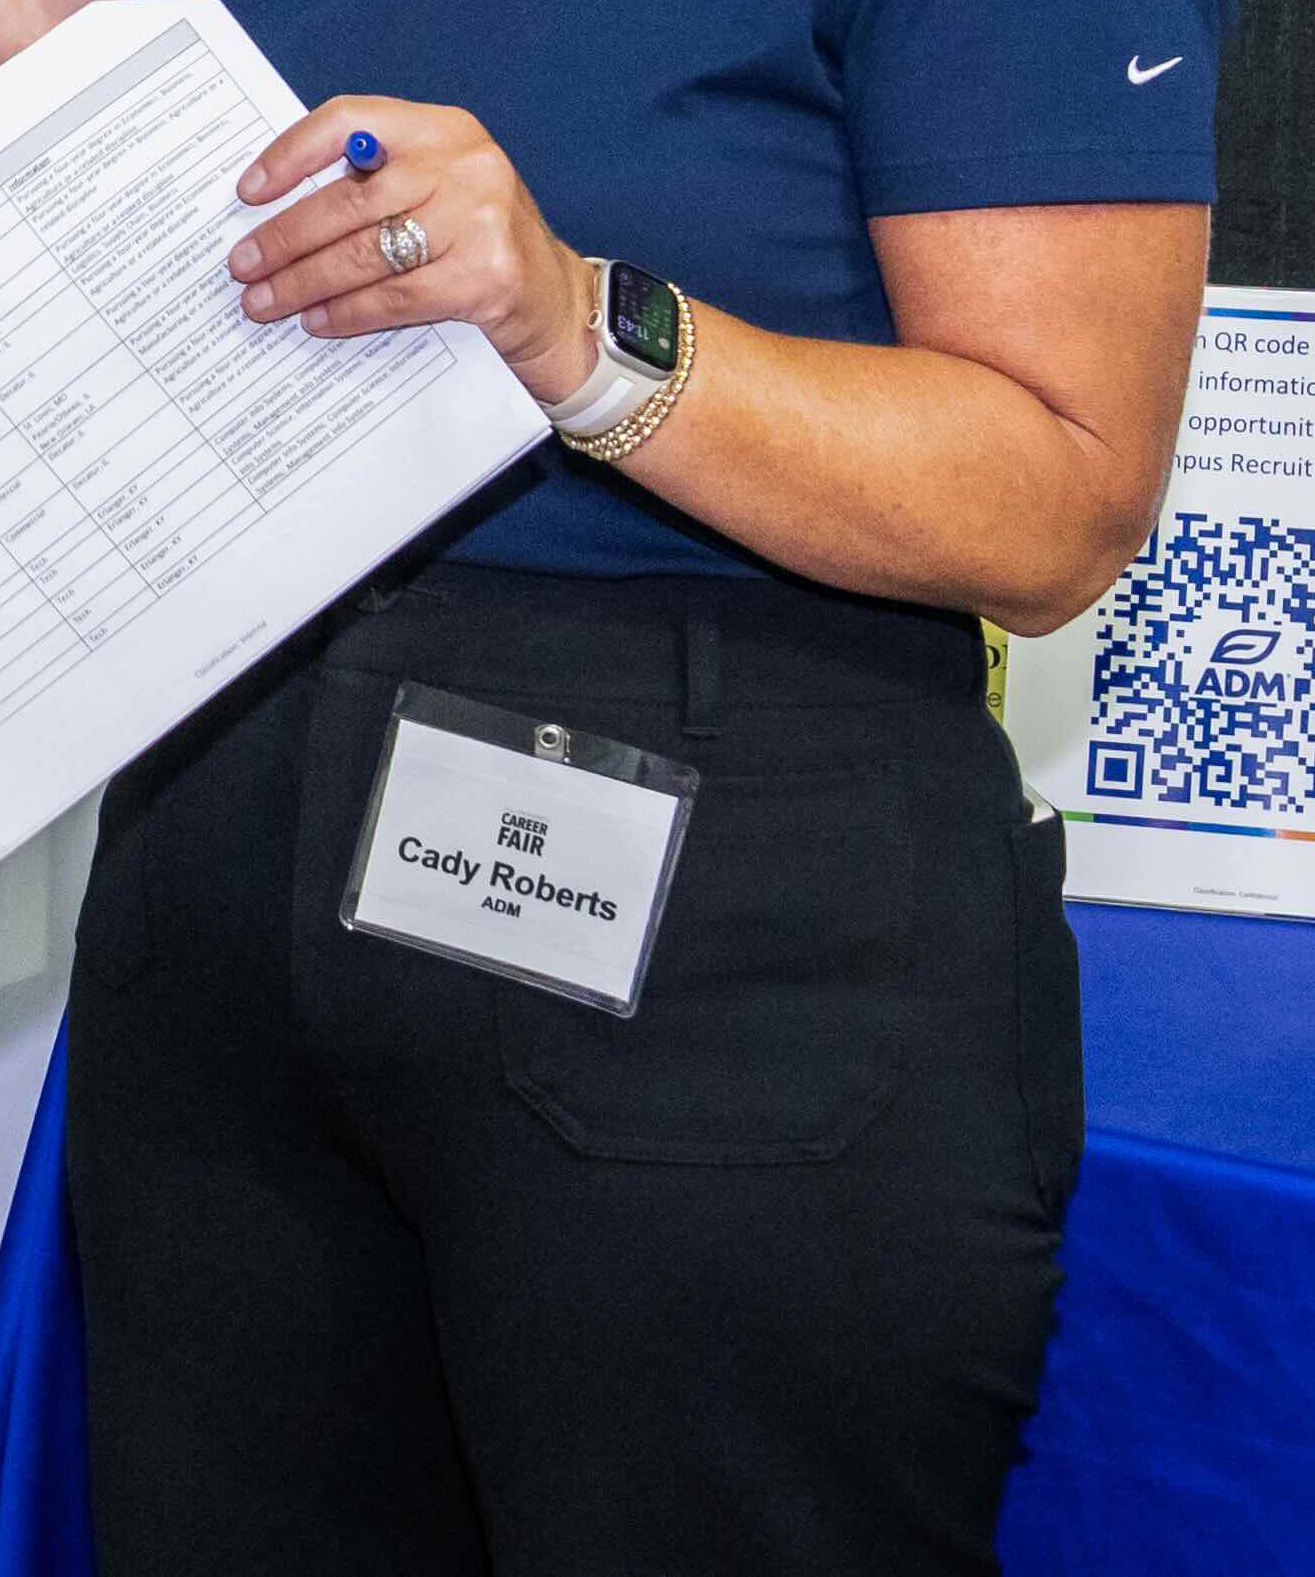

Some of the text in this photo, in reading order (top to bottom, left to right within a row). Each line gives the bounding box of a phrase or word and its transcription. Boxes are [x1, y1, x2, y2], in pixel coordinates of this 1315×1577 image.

[1215, 332, 1247, 353] QR
[1255, 336, 1310, 356] code
[1195, 668, 1286, 701] ADM
[501, 812, 548, 836] CAREER
[496, 826, 545, 857] FAIR
[398, 837, 618, 922] Cady Roberts
[481, 895, 521, 919] ADM
